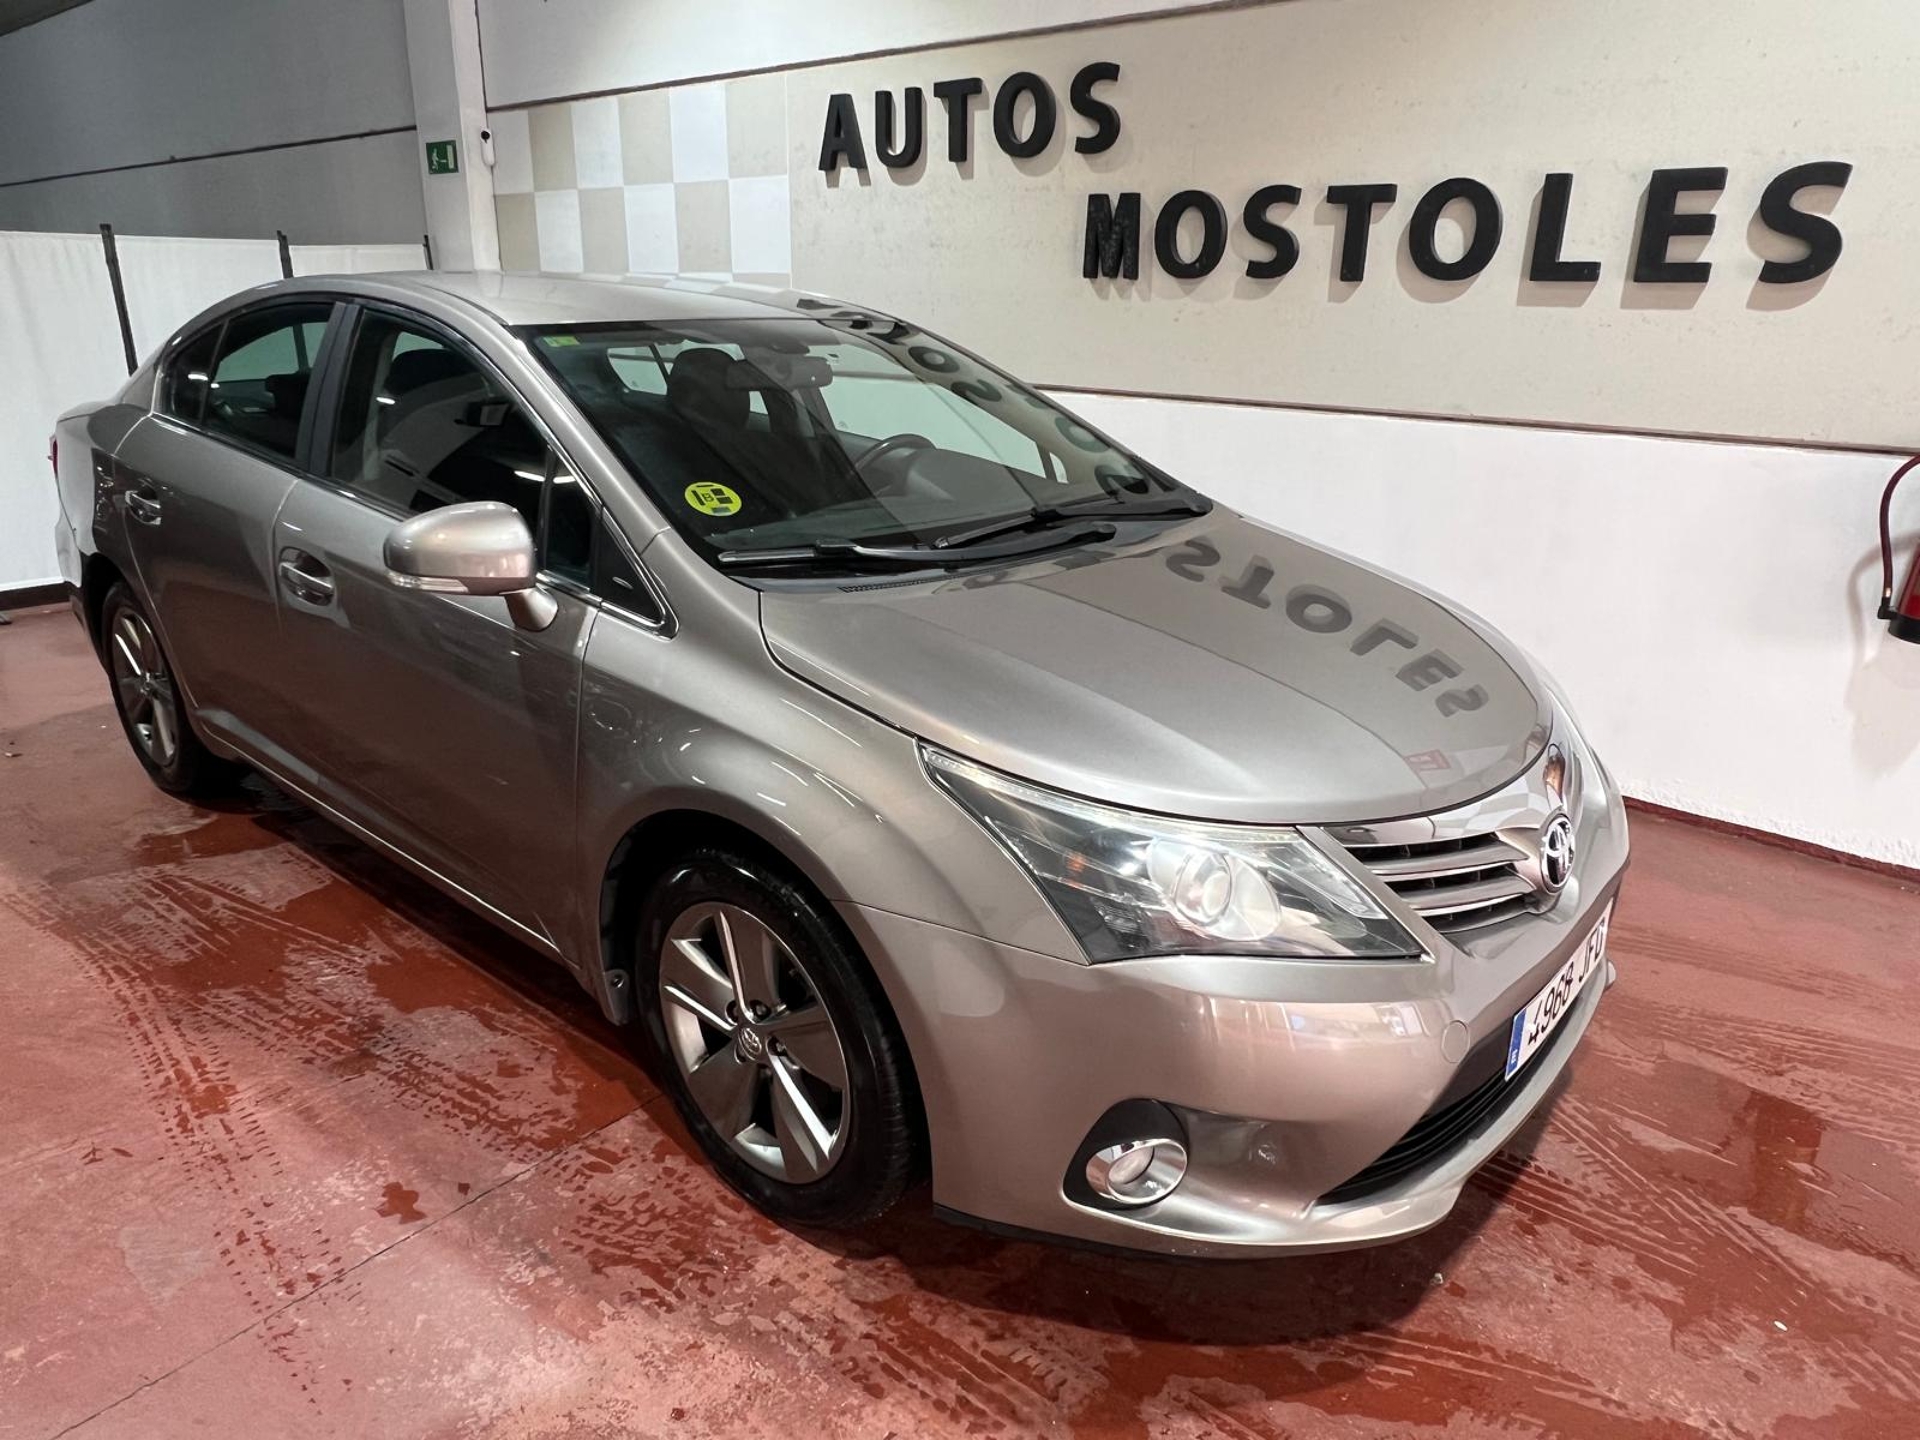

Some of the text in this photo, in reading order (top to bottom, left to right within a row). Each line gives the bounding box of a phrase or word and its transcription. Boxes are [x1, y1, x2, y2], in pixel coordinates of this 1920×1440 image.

[818, 62, 1120, 172] AUTOS
[1083, 161, 1853, 284] MOSTOLES
[1529, 961, 1574, 1045] 4968
